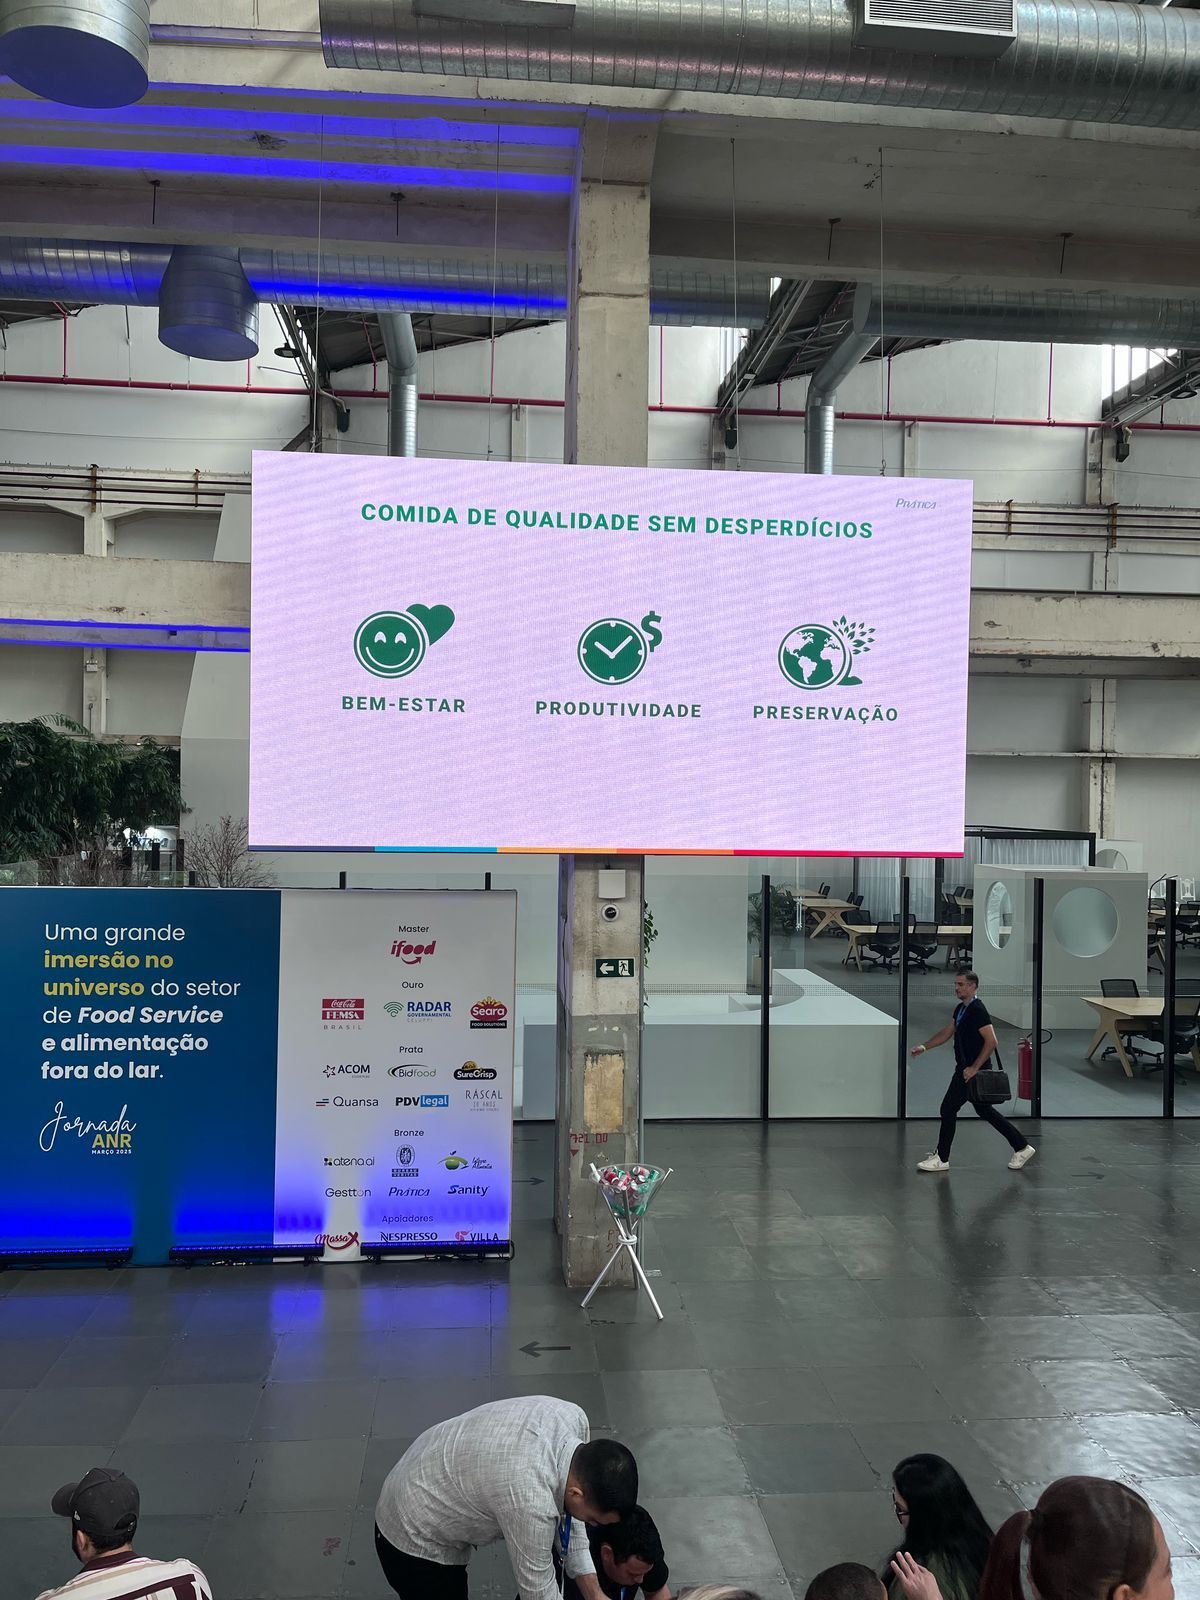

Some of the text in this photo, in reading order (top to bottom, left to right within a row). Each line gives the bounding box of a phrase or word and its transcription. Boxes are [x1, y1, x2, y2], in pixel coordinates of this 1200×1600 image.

[361, 503, 874, 539] COMIDA DE QUALIDADE SEM DESPERDÍCIOS
[342, 696, 466, 713] BEM-ESTAR
[536, 701, 702, 718] PRODUTIVIDADE
[753, 704, 898, 724] PRESERVAÇÃO
[45, 924, 185, 946] Uma grande
[398, 925, 430, 933] Master
[391, 940, 436, 957] ifood
[44, 950, 174, 969] imersão no
[43, 977, 241, 996] universo do setor
[401, 981, 424, 989] Ouro
[407, 1001, 452, 1012] RADAR
[472, 1006, 505, 1016] Seara
[43, 1006, 224, 1024] de Food Service
[42, 1033, 209, 1056] e alimentação
[399, 1045, 424, 1054] Prata
[41, 1060, 164, 1079] fora do lar.
[337, 1064, 370, 1074] ACOM
[398, 1065, 437, 1078] Bidfood
[457, 1069, 495, 1079] SureCrisp
[332, 1095, 379, 1107] Quansa
[39, 1100, 137, 1152] Jornada
[394, 1129, 425, 1138] Bronze
[92, 1133, 132, 1148] ANR
[325, 1187, 372, 1198] Gestton
[447, 1184, 490, 1197] Sanity
[382, 1214, 434, 1224] Apoiadores
[380, 1231, 438, 1242] NESPRESSO
[470, 1232, 499, 1241] VILLA
